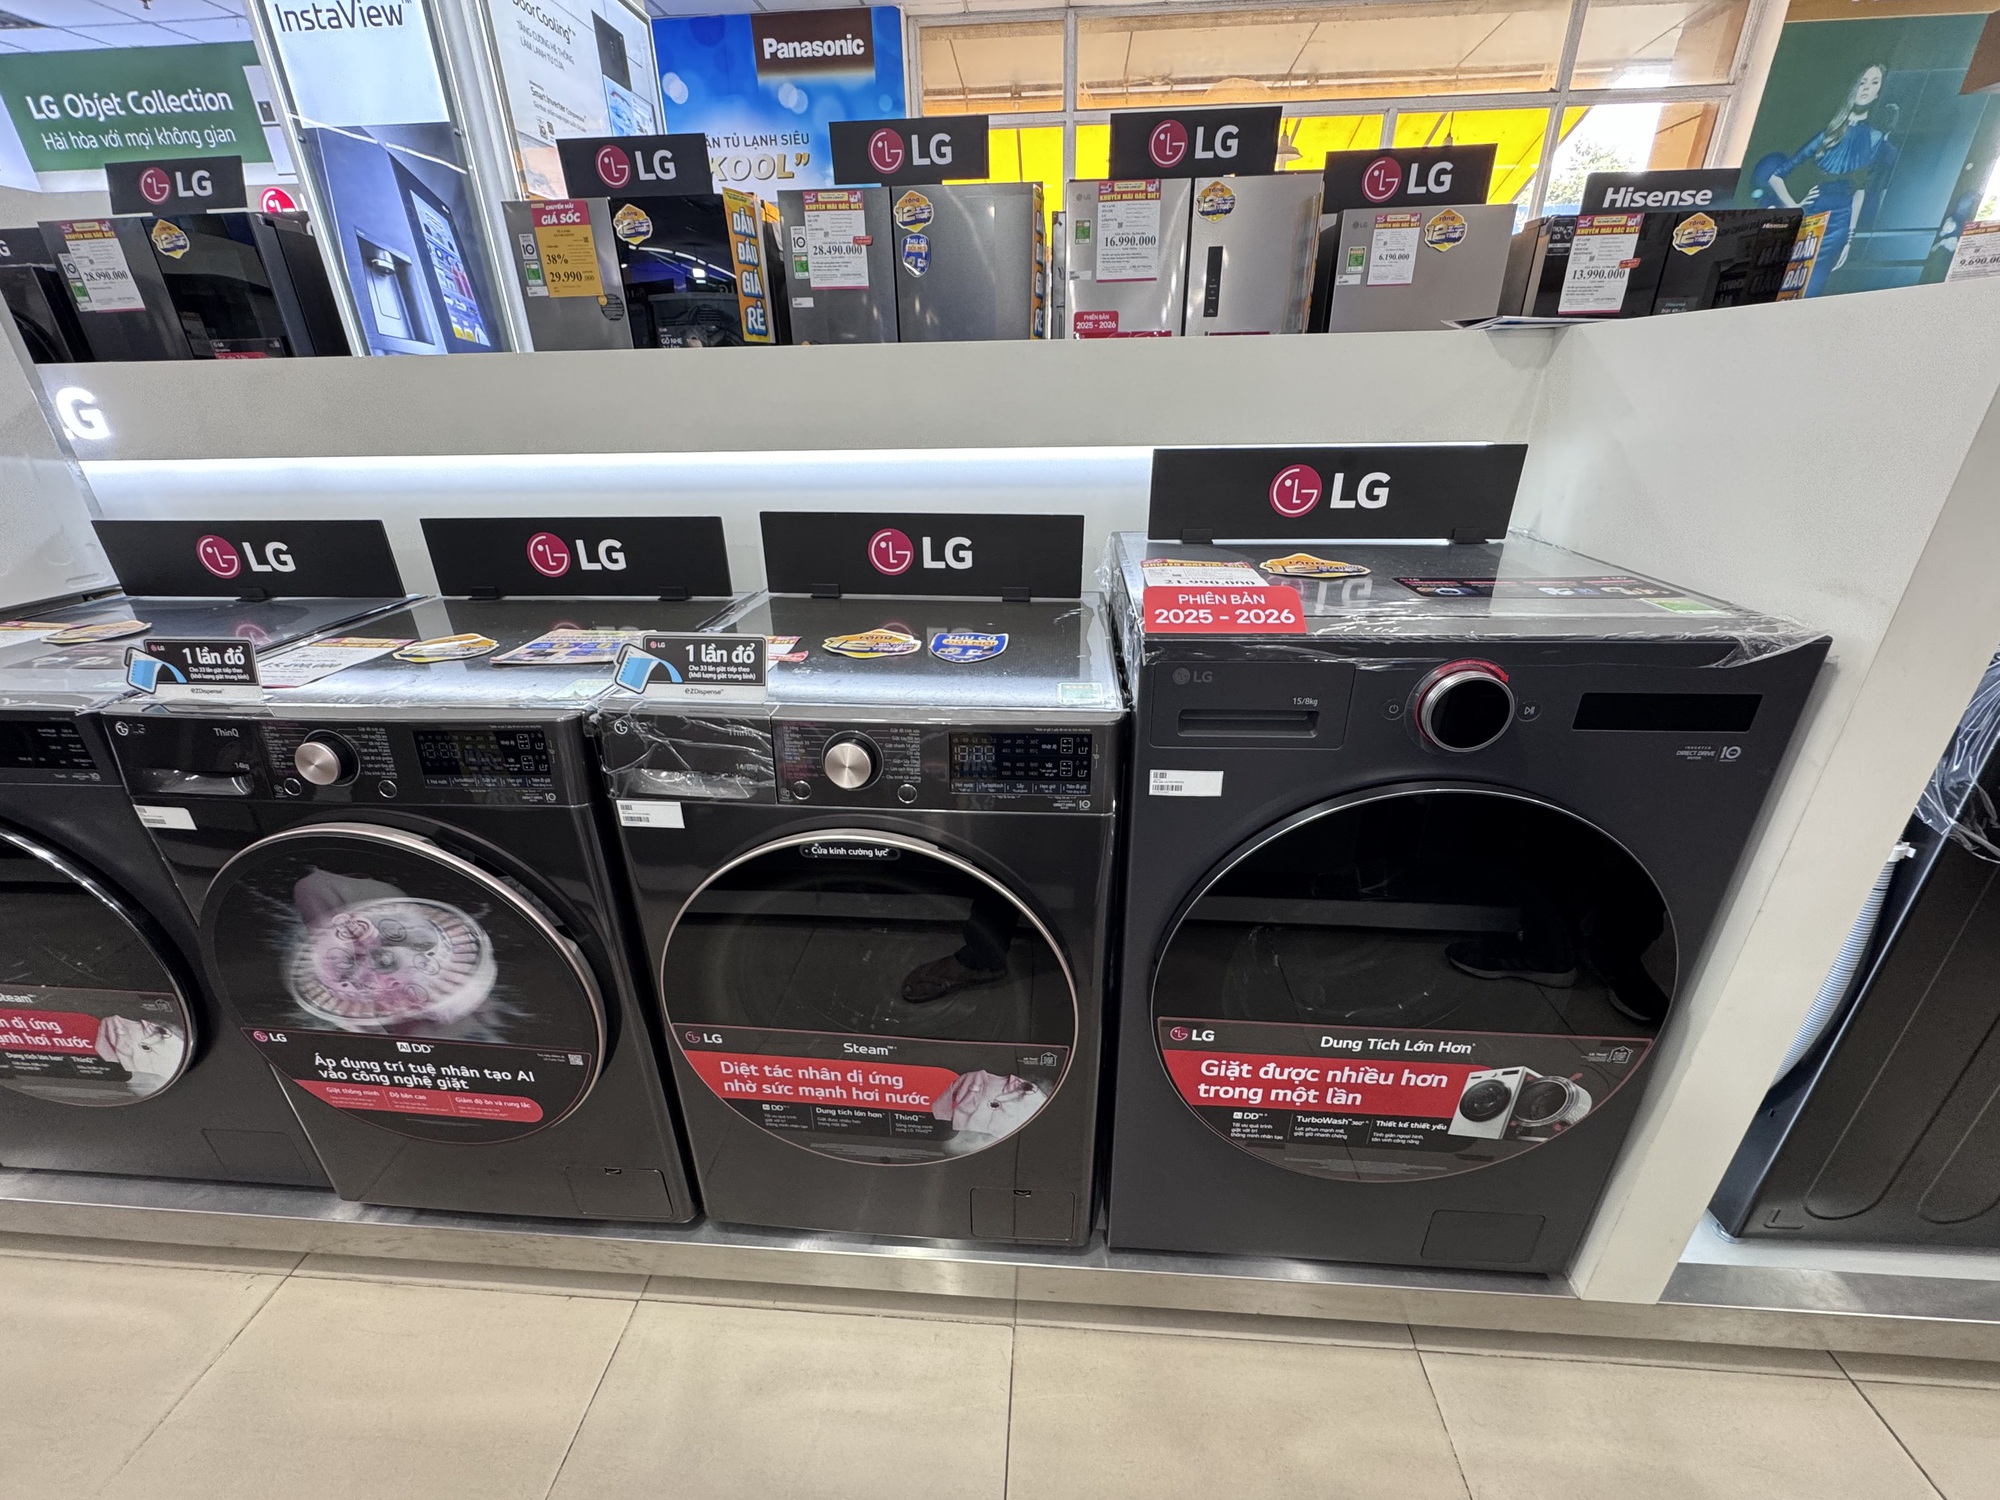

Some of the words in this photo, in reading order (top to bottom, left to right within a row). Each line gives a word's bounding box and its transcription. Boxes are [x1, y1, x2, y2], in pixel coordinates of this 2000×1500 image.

[274, 0, 403, 32] InstaView
[763, 34, 865, 60] Panasonic
[25, 95, 61, 119] LG
[64, 92, 126, 122] Objet
[127, 88, 234, 115] Collection
[41, 132, 69, 150] Hài
[71, 130, 98, 149] hòa
[100, 128, 122, 148] với
[124, 128, 152, 150] mọi
[154, 126, 201, 149] không
[204, 125, 237, 149] gian
[724, 132, 739, 148] TỦ
[744, 134, 777, 150] LẠNH
[781, 130, 809, 145] SIÊU
[1194, 125, 1240, 159] LG
[911, 133, 953, 166] LG
[634, 149, 677, 181] LG
[175, 170, 213, 198] LG
[1406, 161, 1453, 195] LG
[1602, 186, 1713, 209] Hisense
[541, 212, 558, 225] GIÁ
[560, 210, 581, 223] SỐC
[1426, 223, 1446, 240] 12
[1674, 228, 1697, 244] 12
[792, 236, 806, 249] 10
[1105, 235, 1156, 247] 16.990.000
[812, 244, 863, 256] 28.490.000
[1378, 253, 1410, 261] 6.190.000
[546, 253, 569, 265] 38%
[83, 270, 128, 282] 28.990.000
[549, 271, 582, 283] 29.990
[742, 268, 763, 295] GIÁ
[1572, 269, 1625, 281] 13.990.000
[1076, 321, 1093, 329] 2025
[1098, 321, 1117, 329] 2026
[1330, 472, 1391, 509] LG
[242, 541, 296, 573] LG
[575, 538, 627, 571] LG
[922, 536, 973, 569] LG
[1178, 591, 1227, 604] PHIÊN
[1231, 591, 1266, 604] BẢN
[1154, 608, 1213, 624] 2025
[1235, 608, 1296, 624] 2026
[182, 647, 193, 664] 1
[197, 647, 222, 665] lần
[224, 645, 245, 665] đổ
[685, 644, 694, 662] 1
[701, 643, 729, 663] lần
[731, 642, 755, 664] đổ
[702, 672, 717, 680] lượng
[717, 673, 728, 681] giặt
[717, 665, 726, 673] giặt
[727, 665, 737, 673] tiếp
[1193, 671, 1213, 683] LG
[1292, 697, 1318, 707] 15/8kg
[213, 727, 240, 738] ThinQ
[848, 848, 873, 857] cường
[11, 1016, 30, 1032] dị
[29, 1018, 63, 1034] ứng
[22, 1032, 51, 1046] hơi
[52, 1036, 93, 1049] nước
[269, 1033, 287, 1042] LG
[703, 1033, 723, 1044] LG
[1191, 1029, 1215, 1042] LG
[1320, 1036, 1362, 1052] Dung
[1367, 1037, 1400, 1052] Tích
[1404, 1039, 1434, 1053] Lớn
[1438, 1041, 1472, 1054] Hơn
[315, 1052, 336, 1070] Áp
[340, 1057, 380, 1073] dụng
[383, 1060, 404, 1073] trí
[410, 1062, 436, 1077] tuệ
[441, 1064, 480, 1078] nhân
[483, 1068, 512, 1082] tạo
[517, 1070, 535, 1083] AI
[720, 1061, 759, 1078] Diệt
[763, 1064, 793, 1078] tác
[798, 1066, 841, 1082] nhân
[847, 1069, 863, 1086] dị
[868, 1071, 903, 1089] ứng
[1200, 1059, 1252, 1081] Giặt
[1258, 1062, 1319, 1082] được
[1326, 1065, 1394, 1086] nhiều
[1401, 1069, 1448, 1087] hơn
[318, 1069, 348, 1080] vào
[351, 1071, 390, 1085] công
[394, 1073, 432, 1088] nghệ
[437, 1076, 469, 1090] giặt
[724, 1079, 757, 1093] nhờ
[762, 1082, 794, 1096] sức
[799, 1085, 847, 1100] mạnh
[852, 1088, 879, 1102] hơi
[885, 1091, 930, 1105] nước
[1198, 1083, 1262, 1104] trong
[1270, 1086, 1319, 1106] một
[1326, 1087, 1362, 1106] lần
[816, 1107, 836, 1116] Dung
[837, 1108, 852, 1116] tích
[854, 1109, 866, 1117] lớn
[867, 1110, 882, 1118] hơn
[1376, 1120, 1397, 1128] Thiết
[1398, 1120, 1409, 1128] kế
[1411, 1121, 1430, 1129] thiết
[1431, 1122, 1447, 1131] yếu
